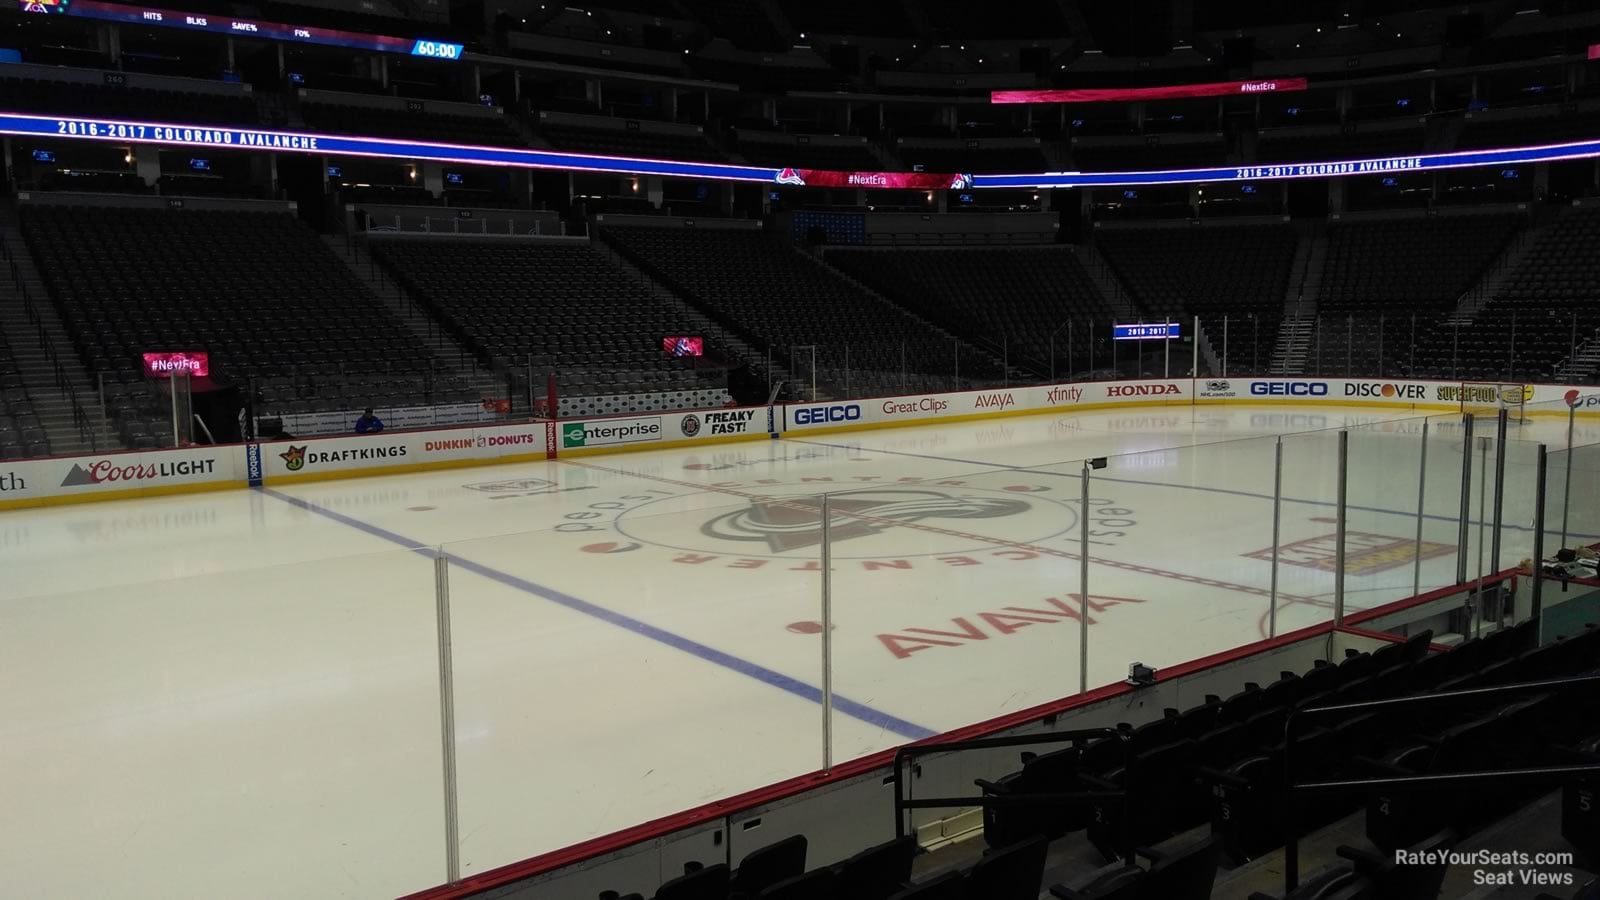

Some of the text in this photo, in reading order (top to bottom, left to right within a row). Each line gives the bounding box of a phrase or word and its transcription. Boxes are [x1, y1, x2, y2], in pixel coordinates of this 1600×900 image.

[143, 11, 311, 39] HITS BLKS SAVE% FO%
[418, 42, 456, 58] 60:00
[1240, 80, 1276, 93] #NextEra
[57, 120, 319, 150] 2016-2017 COLORADO AVALANCHE
[1236, 158, 1422, 178] 2016-2017 COLORADO AVALANCHE
[848, 175, 887, 187] #NextEra
[1128, 327, 1166, 336] 2016-2017
[1046, 386, 1083, 404] xfinity
[1106, 383, 1182, 397] HONDA
[1250, 381, 1329, 396] GEICO
[1344, 382, 1425, 400] DISCOVER
[1436, 385, 1497, 403] SUPERFOOD
[882, 398, 948, 414] Great Clips
[974, 393, 1015, 410] AVAYA
[705, 410, 755, 424] FREAKY
[794, 404, 861, 425] GEICO
[564, 423, 660, 441] enterprise
[711, 422, 747, 434] FAST!
[424, 433, 534, 452] DUNKIN' DONUTS
[249, 444, 259, 478] Reebok
[308, 445, 407, 464] DRAFTKINGS
[90, 458, 216, 482] Coors LIGHT
[876, 592, 1149, 660] AVAYA
